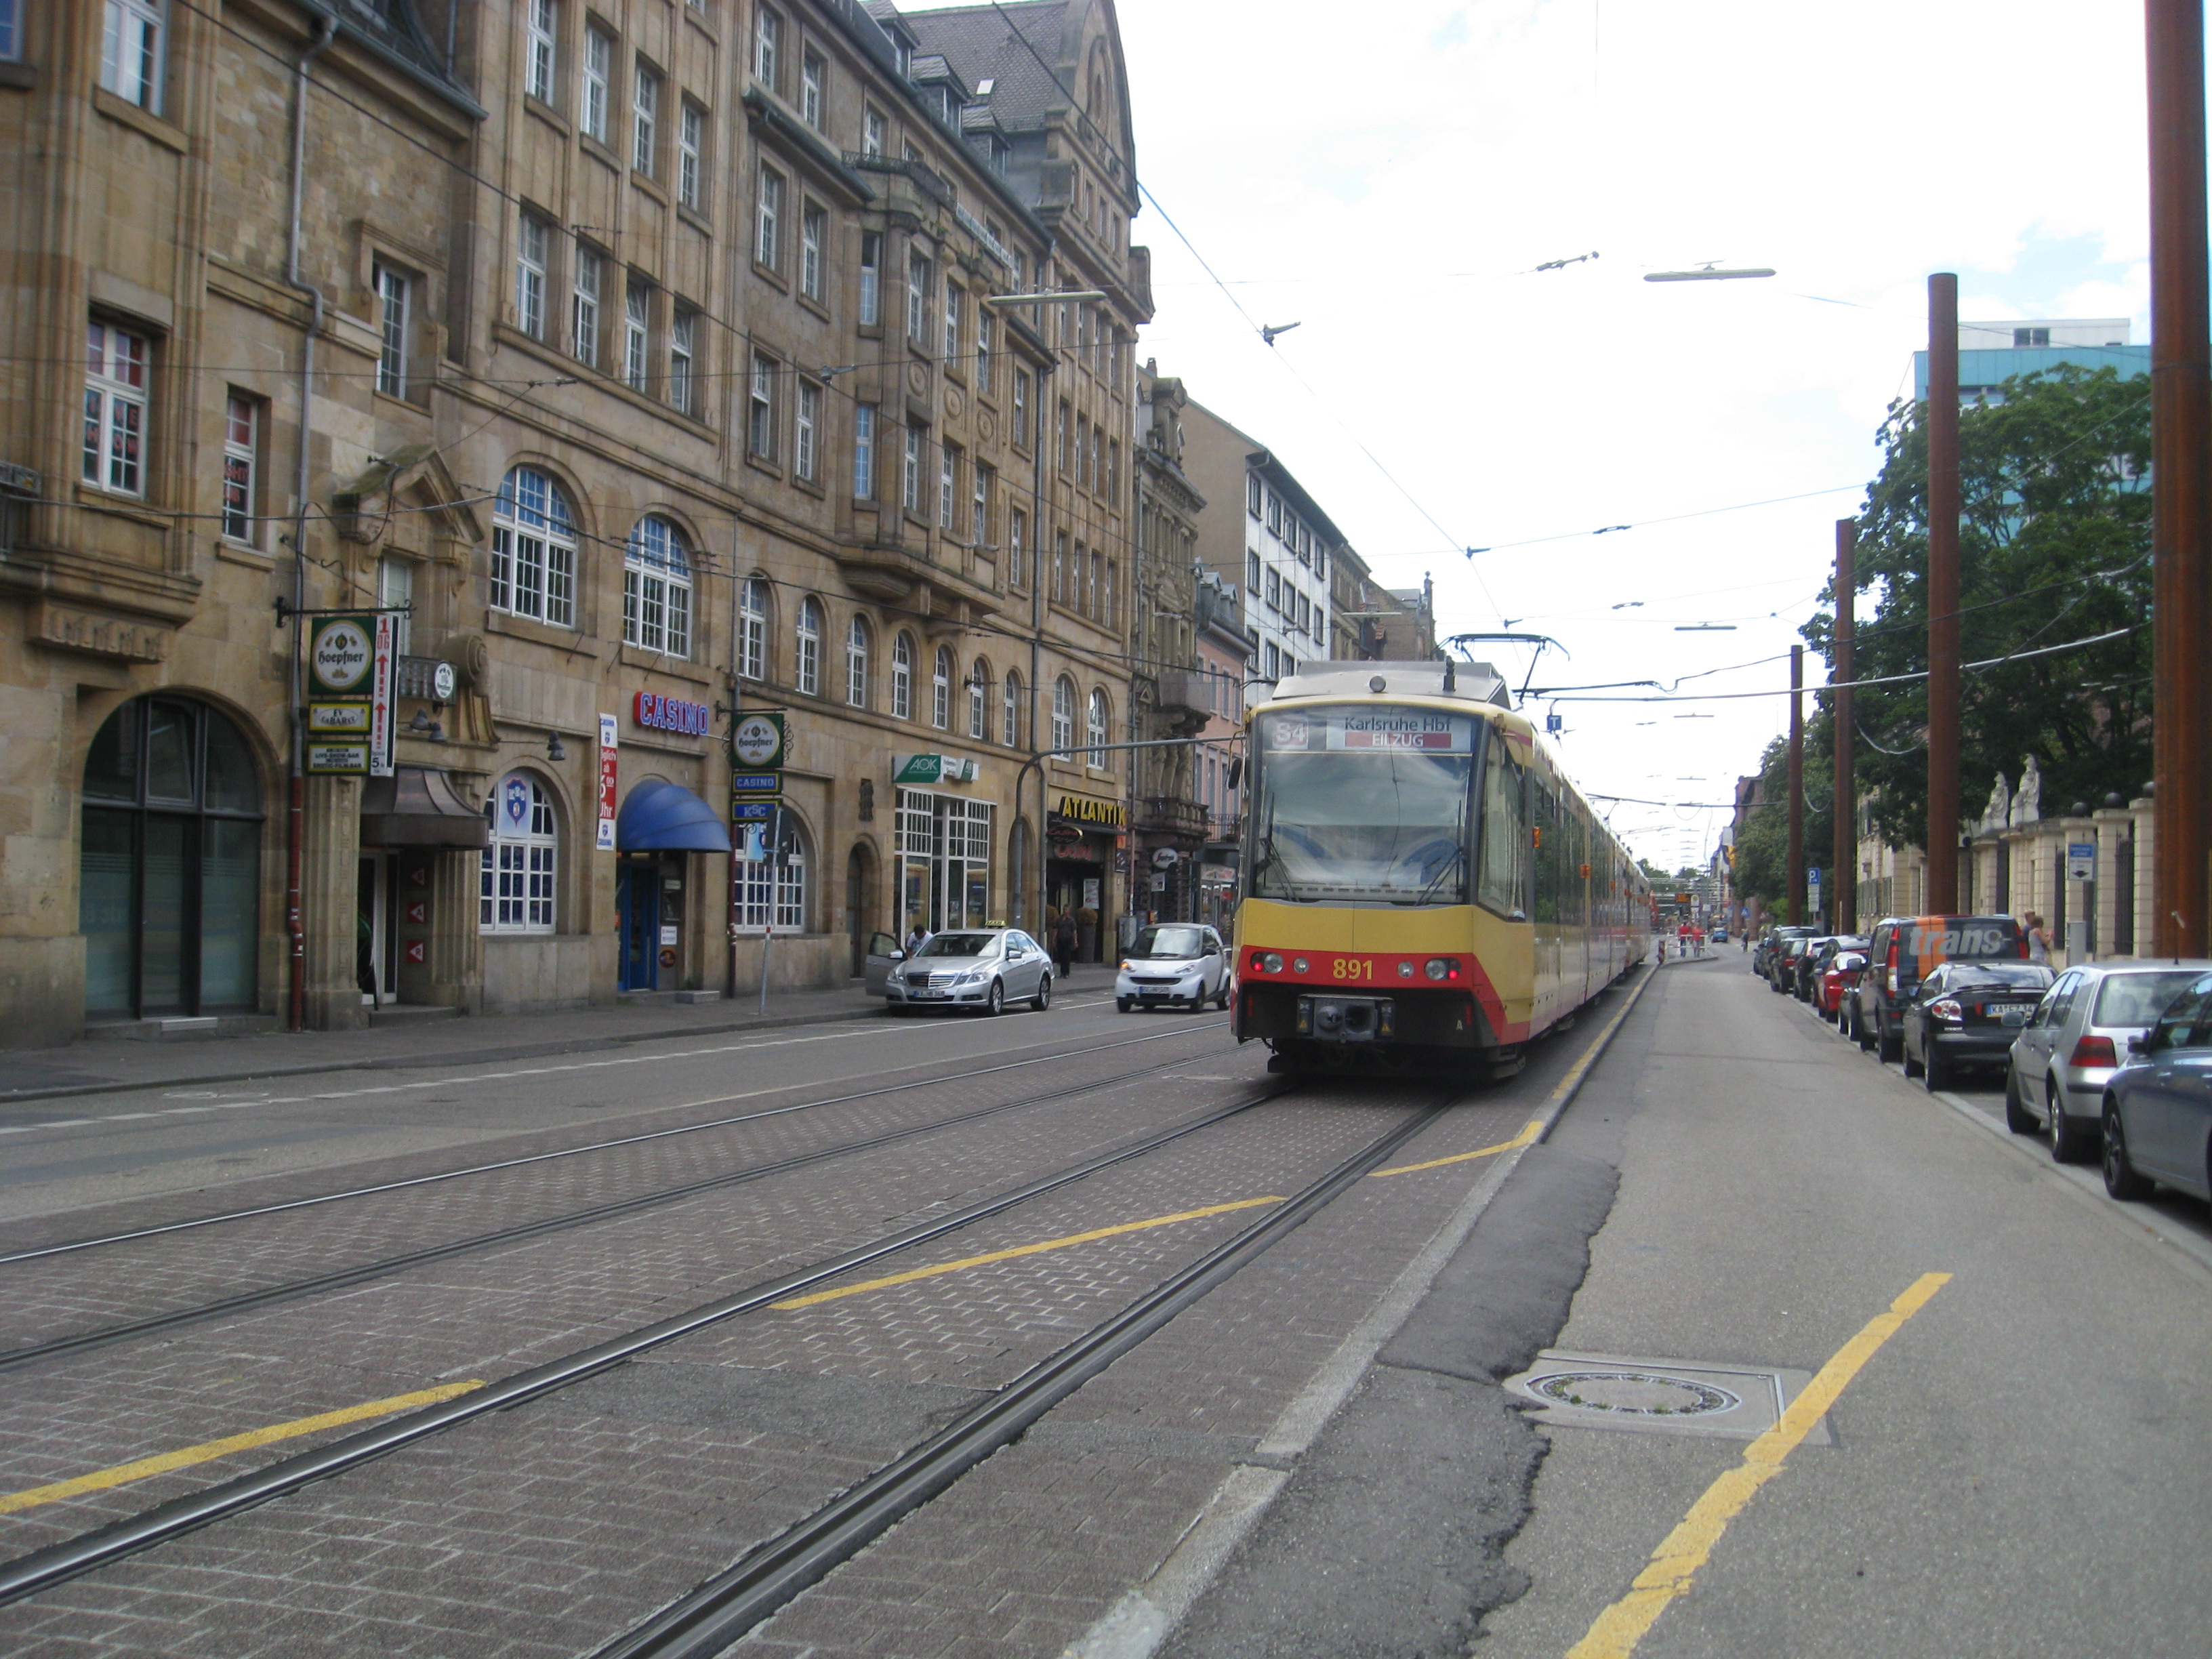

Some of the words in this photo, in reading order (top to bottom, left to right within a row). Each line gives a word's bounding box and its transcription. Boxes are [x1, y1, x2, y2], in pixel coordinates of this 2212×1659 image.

[88, 395, 137, 426] IVE
[318, 651, 364, 665] Hoepfner
[640, 693, 709, 736] CASINO
[1345, 717, 1418, 731] Karlsruhe
[1424, 718, 1452, 732] Hbf
[1550, 717, 1559, 728] T
[1276, 723, 1306, 742] S4
[738, 738, 773, 748] Hoepfner
[909, 758, 937, 771] AOK
[736, 778, 775, 787] CASINO
[743, 804, 766, 817] KSC
[1061, 796, 1126, 825] ATLANTIK
[1809, 870, 1816, 883] P
[1332, 958, 1372, 980] 891
[1456, 1020, 1463, 1030] A
